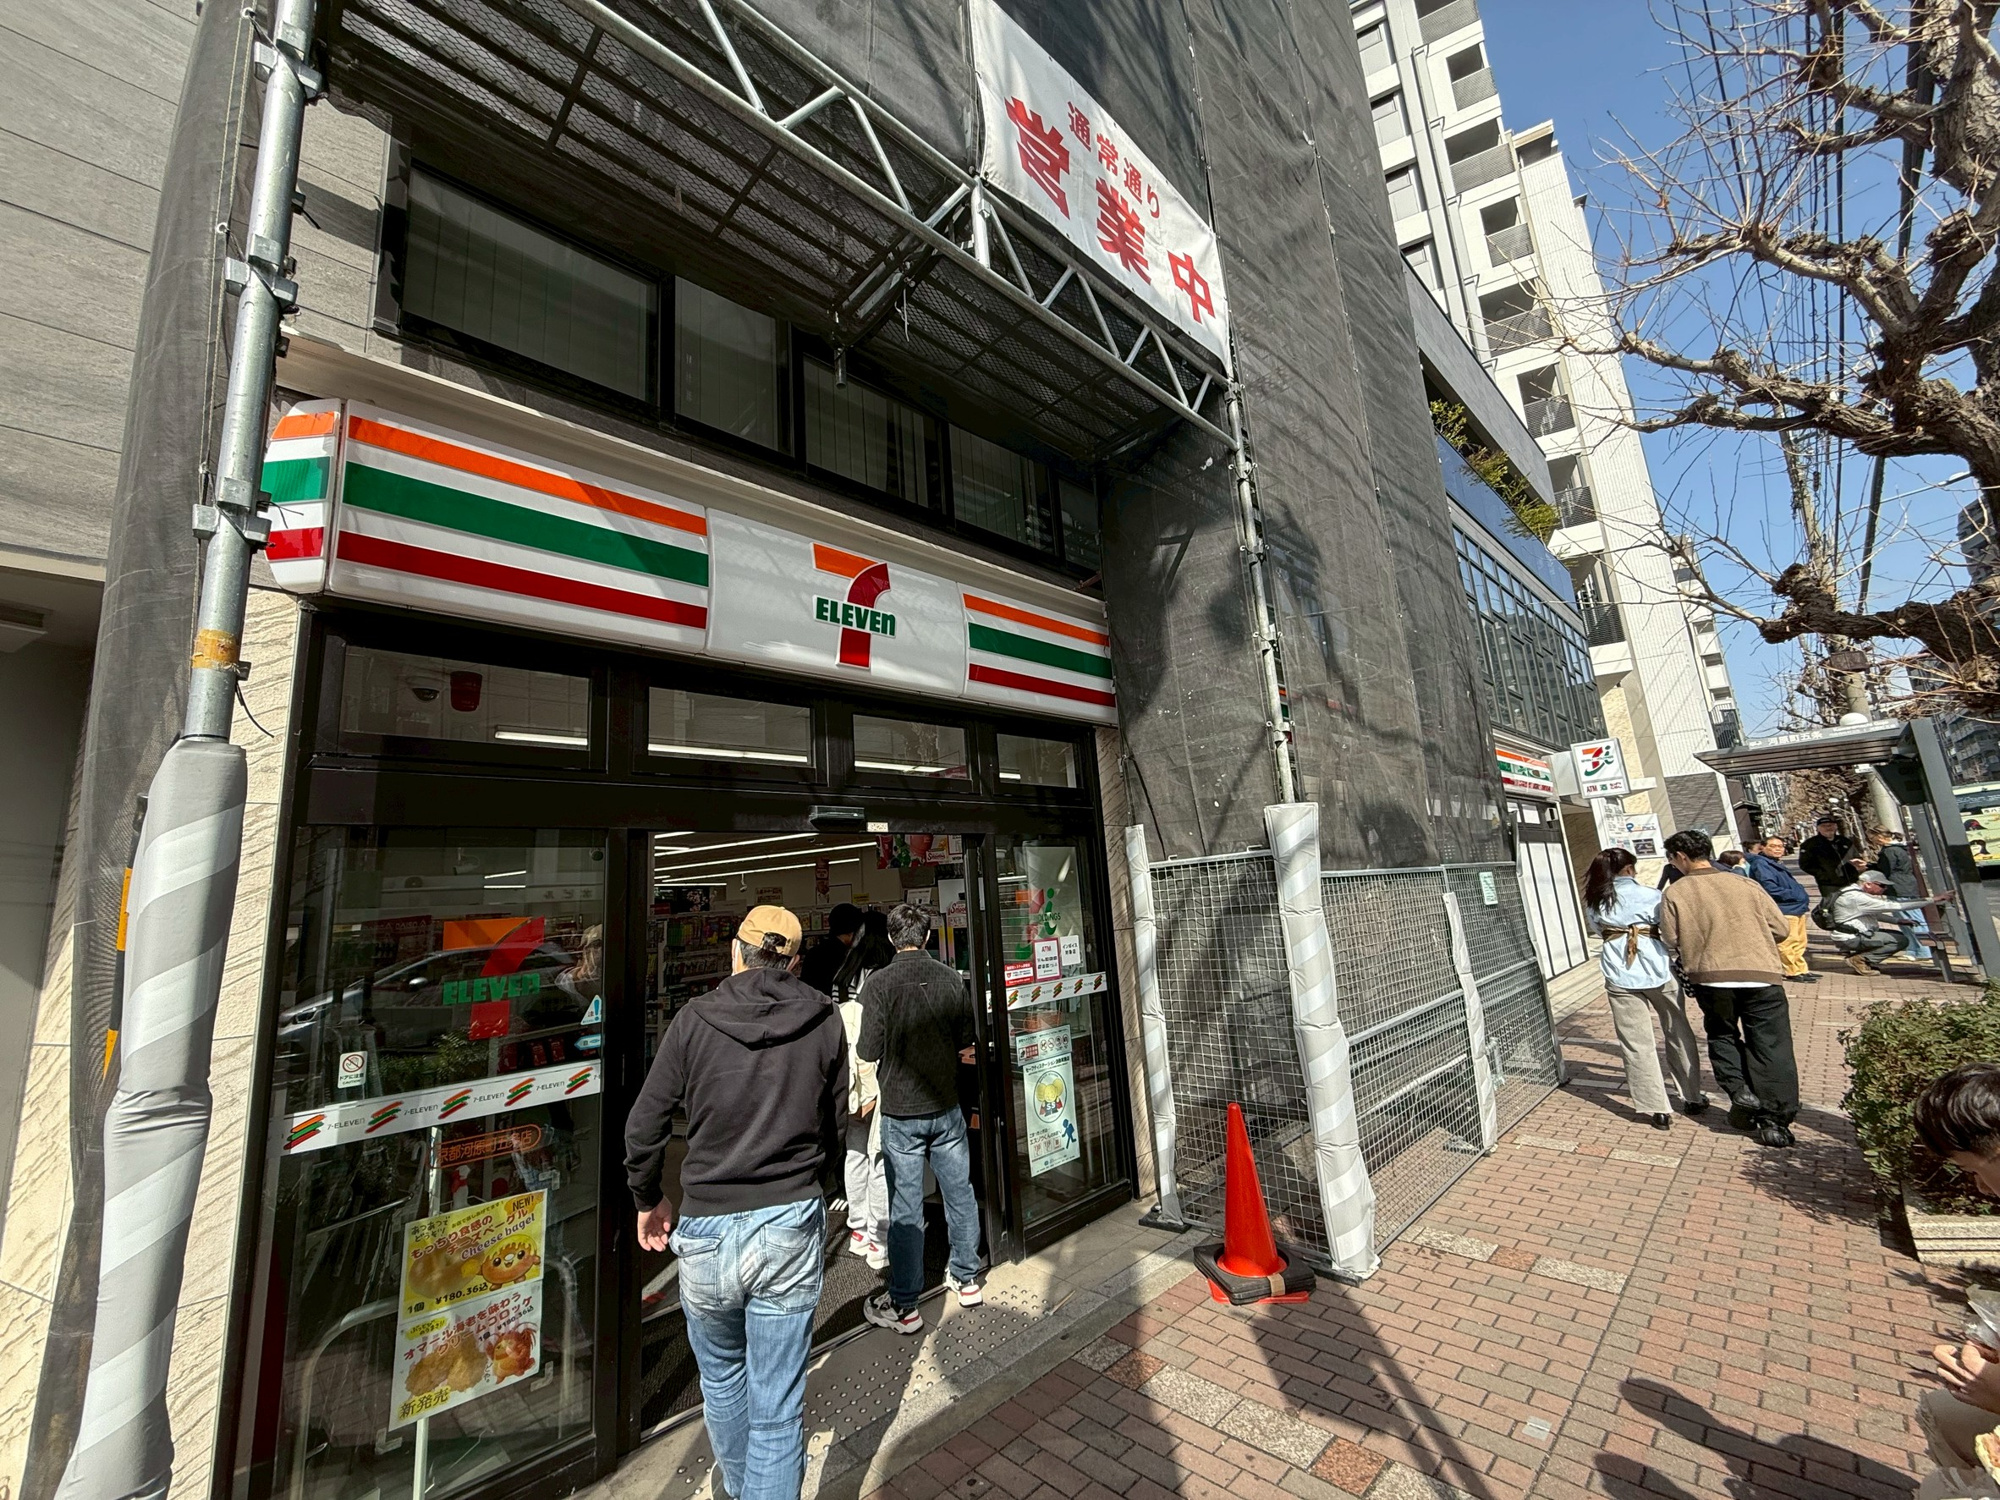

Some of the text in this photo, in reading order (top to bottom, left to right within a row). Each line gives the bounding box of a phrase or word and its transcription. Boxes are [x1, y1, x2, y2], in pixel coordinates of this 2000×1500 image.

[1067, 101, 1160, 219] 通常通り
[1004, 96, 1216, 325] 営業中
[411, 1215, 451, 1236] あつあつで
[512, 1195, 535, 1212] NEW!
[411, 1214, 493, 1260] もっちり食感の
[446, 1208, 528, 1256] チーズベーグル
[460, 1213, 536, 1261] Cheese bagel
[403, 1291, 521, 1361] オマール海老を味わう
[407, 1301, 425, 1314] 1個
[437, 1295, 533, 1356] クリームコロッケ
[478, 1331, 491, 1342] 1個
[399, 1388, 449, 1419] 新発売
